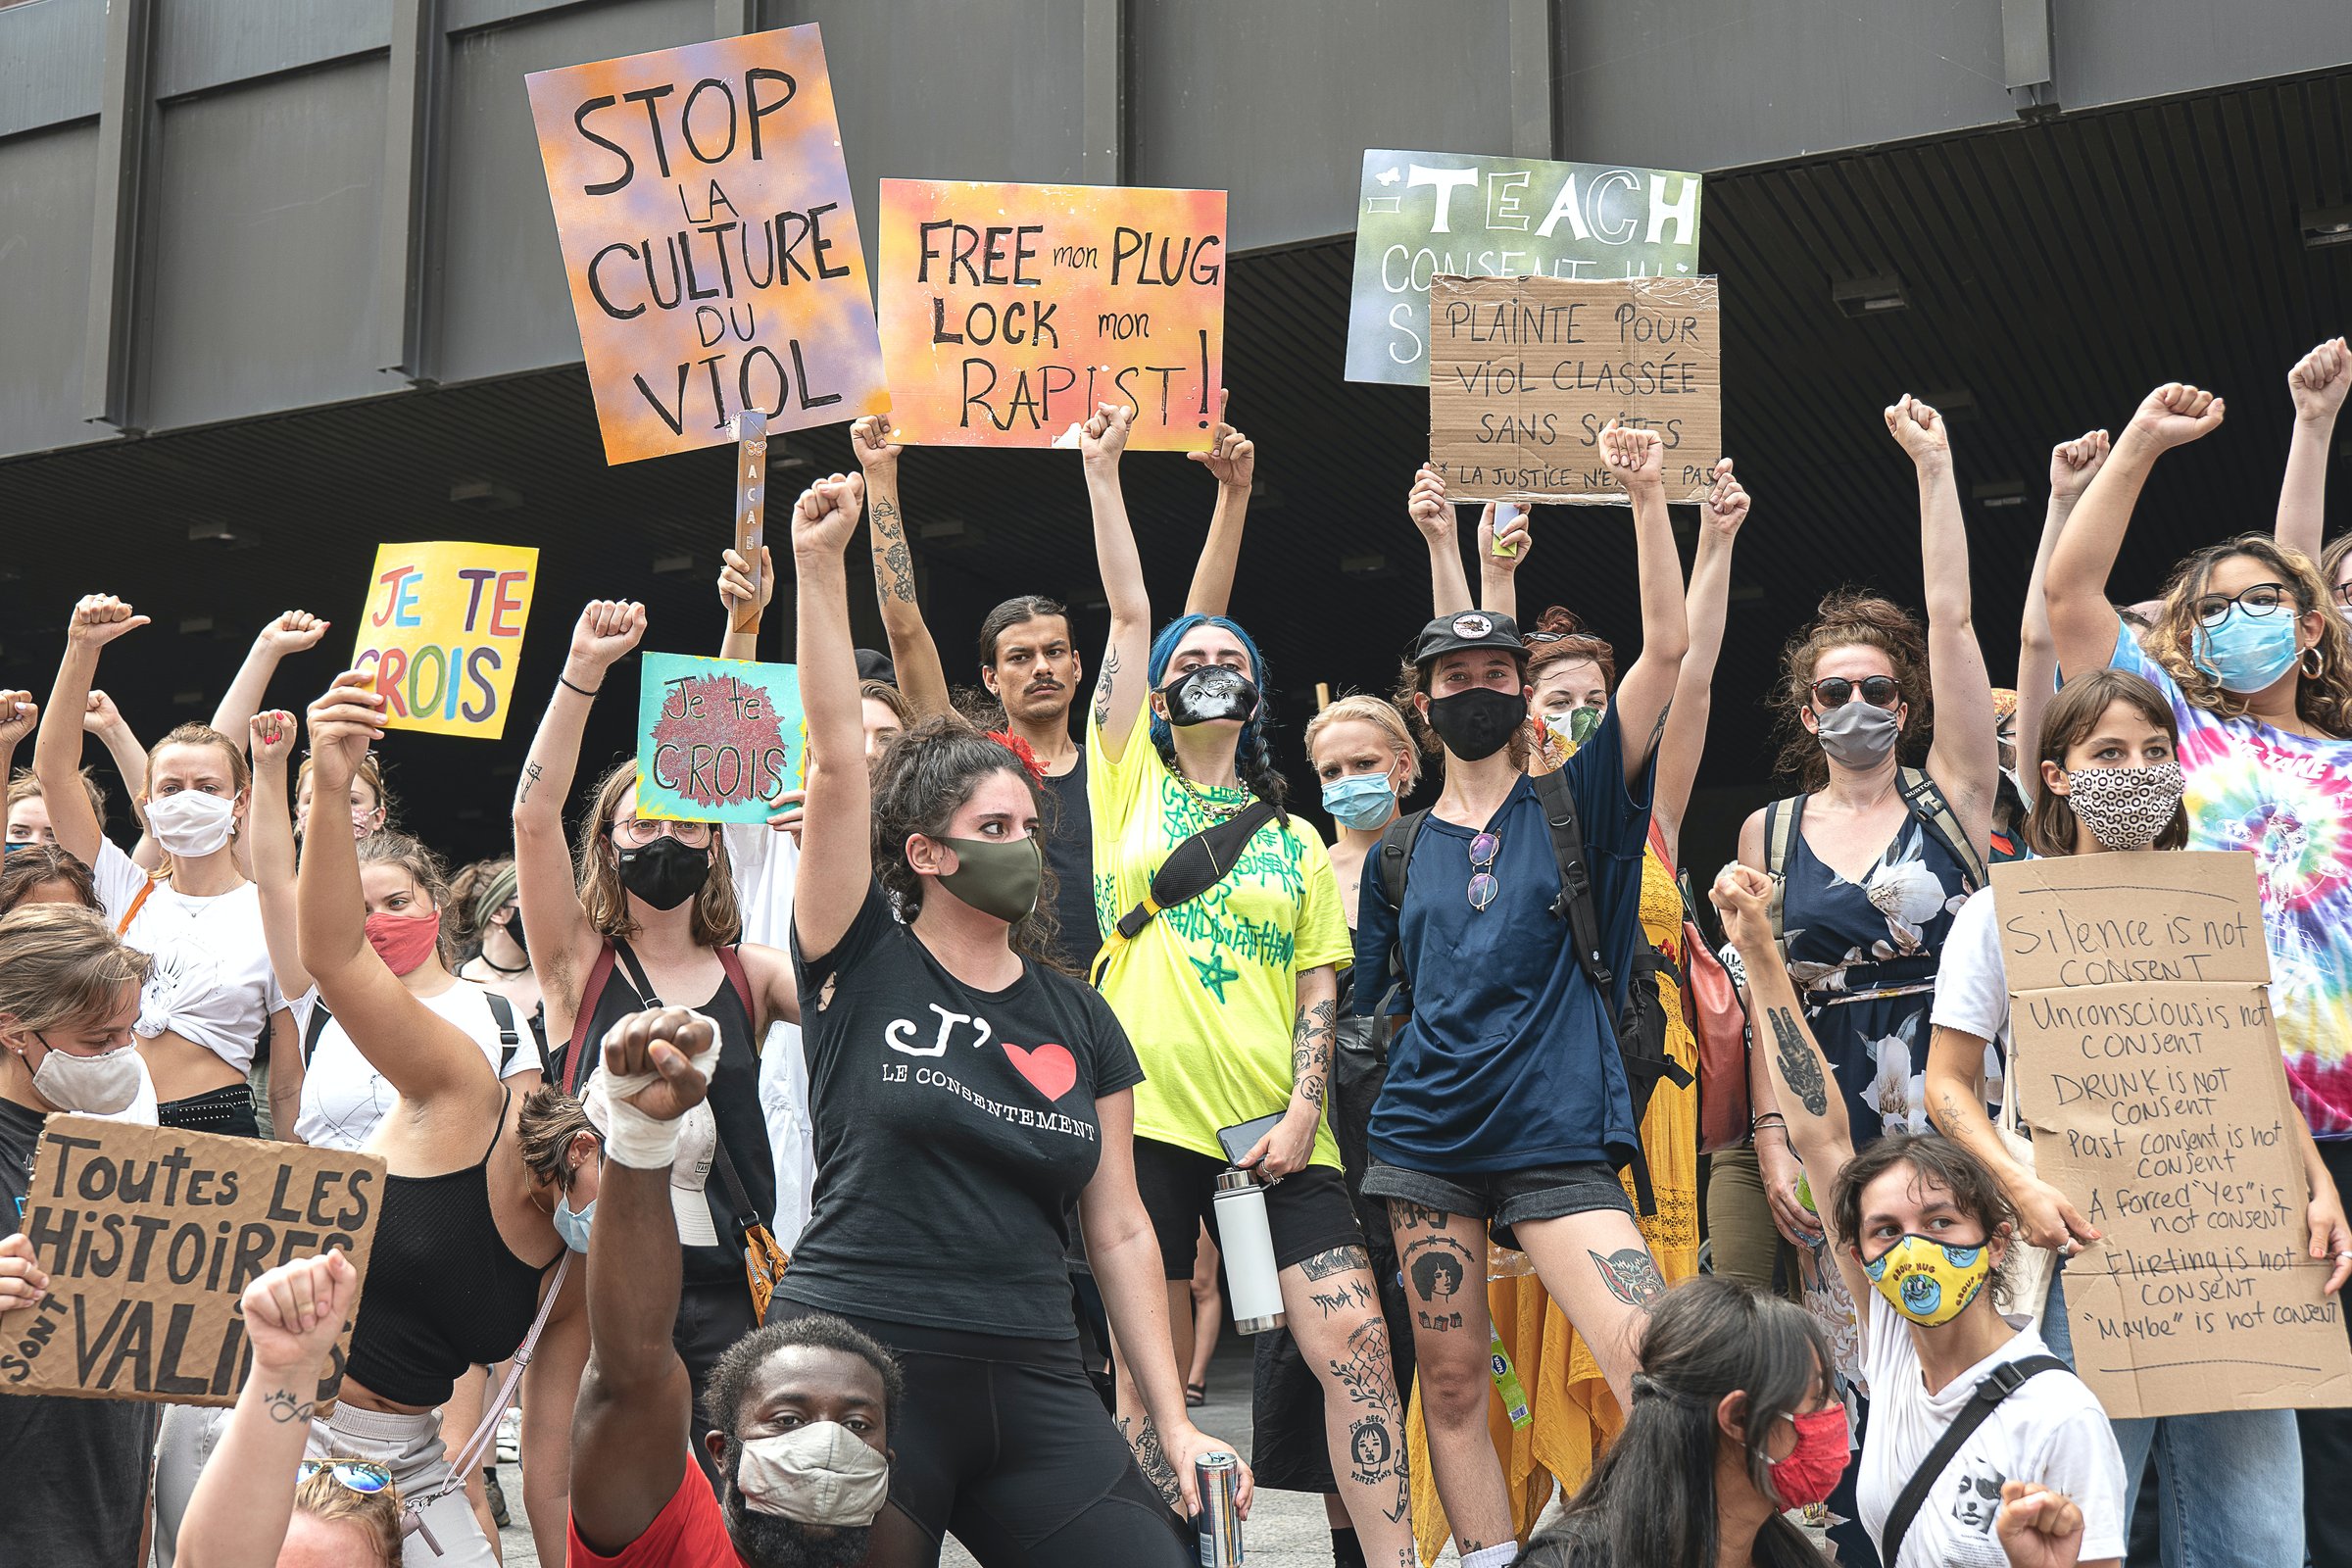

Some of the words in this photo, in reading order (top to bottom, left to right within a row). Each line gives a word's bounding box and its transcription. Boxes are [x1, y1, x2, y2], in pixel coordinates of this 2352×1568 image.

[574, 69, 797, 195] STOP
[679, 179, 739, 224] LA
[1406, 164, 1698, 245] TEACH
[588, 203, 851, 319] CULTURE
[918, 219, 1044, 286] FREE
[1054, 246, 1098, 270] mon
[1111, 227, 1220, 286] PLUG
[695, 303, 756, 347] DU
[933, 297, 1058, 349] LOCK
[1099, 313, 1150, 340] mon
[1615, 303, 1699, 343] POUR
[633, 339, 843, 436] VIOL
[1553, 352, 1697, 395] CLASSÉE
[1476, 413, 1558, 446] SANS
[1460, 466, 1483, 484] LA
[1683, 465, 1715, 487] PAS
[372, 565, 423, 628] JE
[459, 568, 528, 637] TE
[663, 675, 706, 720] Je
[727, 676, 761, 720] te
[653, 743, 786, 802] CROIS
[1905, 780, 1935, 798] BURTON
[2006, 909, 2154, 955] Silence
[2163, 913, 2190, 944] is
[2205, 911, 2248, 949] not
[885, 1004, 992, 1056] J'
[2030, 998, 2204, 1029] Unconscious
[2207, 999, 2230, 1029] is
[2239, 999, 2268, 1027] not
[882, 1064, 907, 1082] LE
[916, 1067, 1095, 1141] CONSENTEMENT
[2051, 1068, 2160, 1105] DRUNK
[2193, 1067, 2230, 1094] NOT
[2068, 1128, 2126, 1159] Past
[2227, 1124, 2243, 1149] is
[2251, 1120, 2281, 1148] not
[267, 1163, 373, 1232] LES
[2089, 1189, 2107, 1224] A
[2117, 1184, 2190, 1217] forced
[2260, 1185, 2285, 1209] is
[2151, 1207, 2199, 1233] not
[1892, 1263, 1912, 1281] GROUP
[1916, 1262, 1936, 1274] HUG
[2259, 1247, 2296, 1271] not
[1956, 1276, 1975, 1306] GROUP
[1, 1293, 70, 1383] SONT
[2195, 1311, 2214, 1333] is
[2229, 1301, 2265, 1330] not
[1366, 1414, 1386, 1424] SEEN
[1377, 1469, 1392, 1483] DAYS
